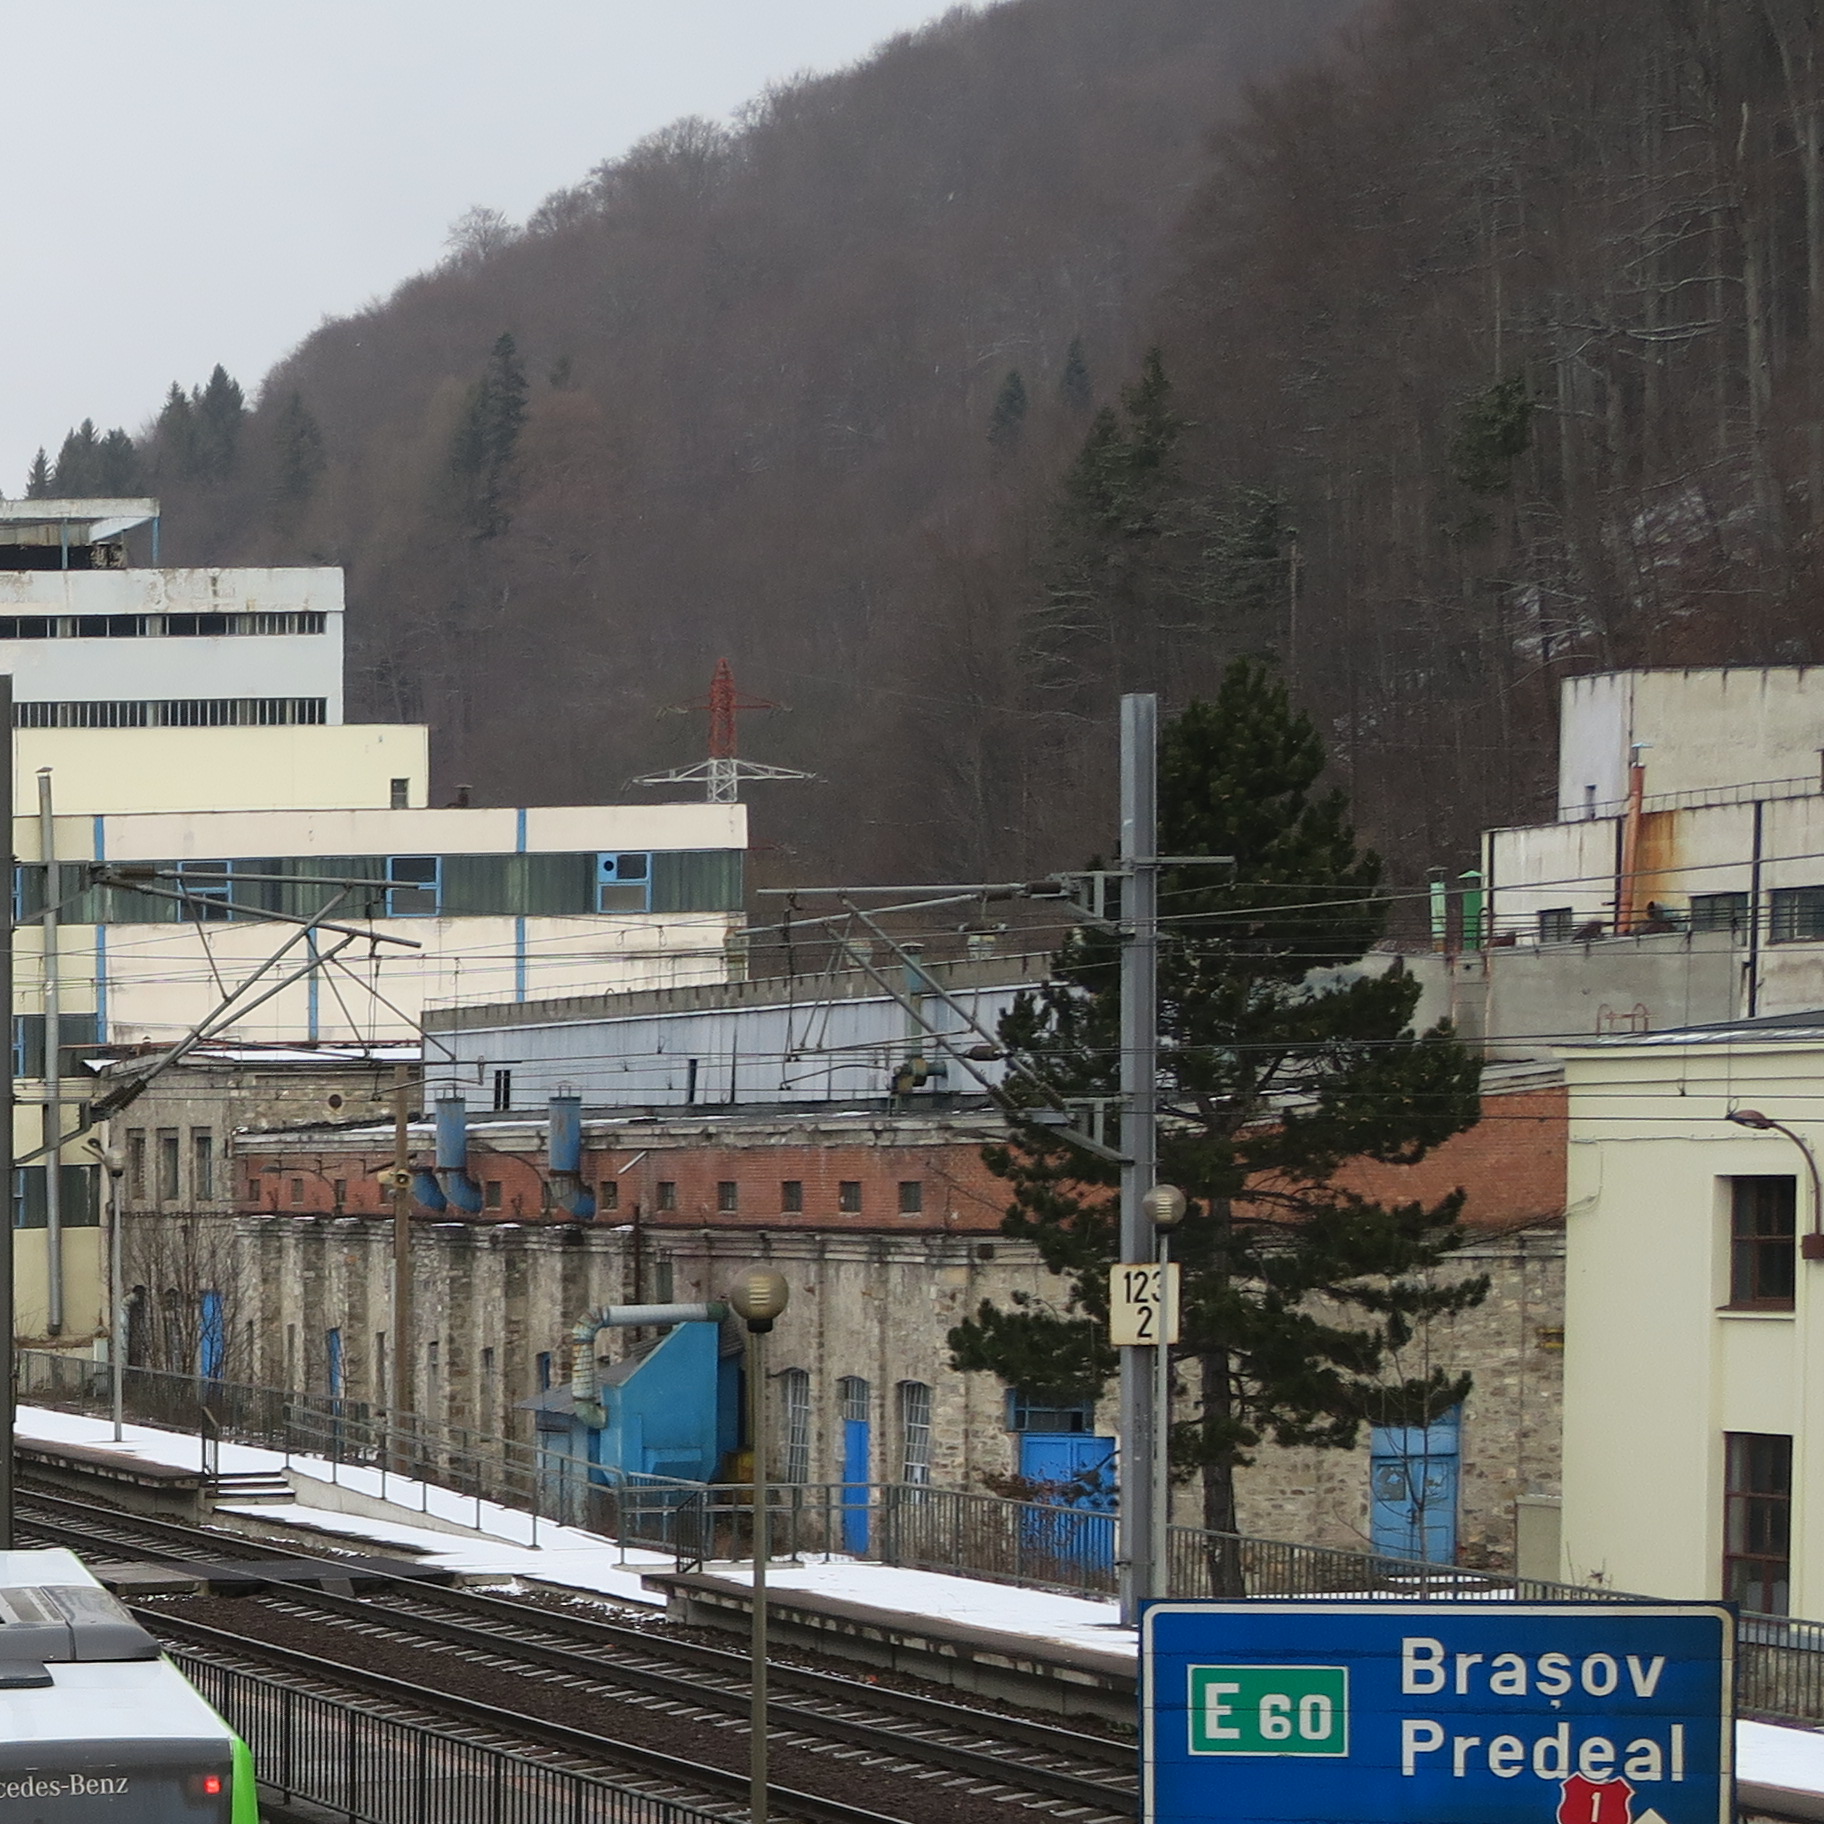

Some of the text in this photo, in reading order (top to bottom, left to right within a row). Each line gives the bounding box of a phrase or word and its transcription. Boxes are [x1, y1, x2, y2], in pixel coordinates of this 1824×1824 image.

[1136, 1305, 1153, 1338] 2
[1401, 1636, 1666, 1711] Brașov
[1203, 1683, 1333, 1741] E 60
[1401, 1719, 1684, 1782] Predeal
[1588, 1791, 1601, 1824] 1
